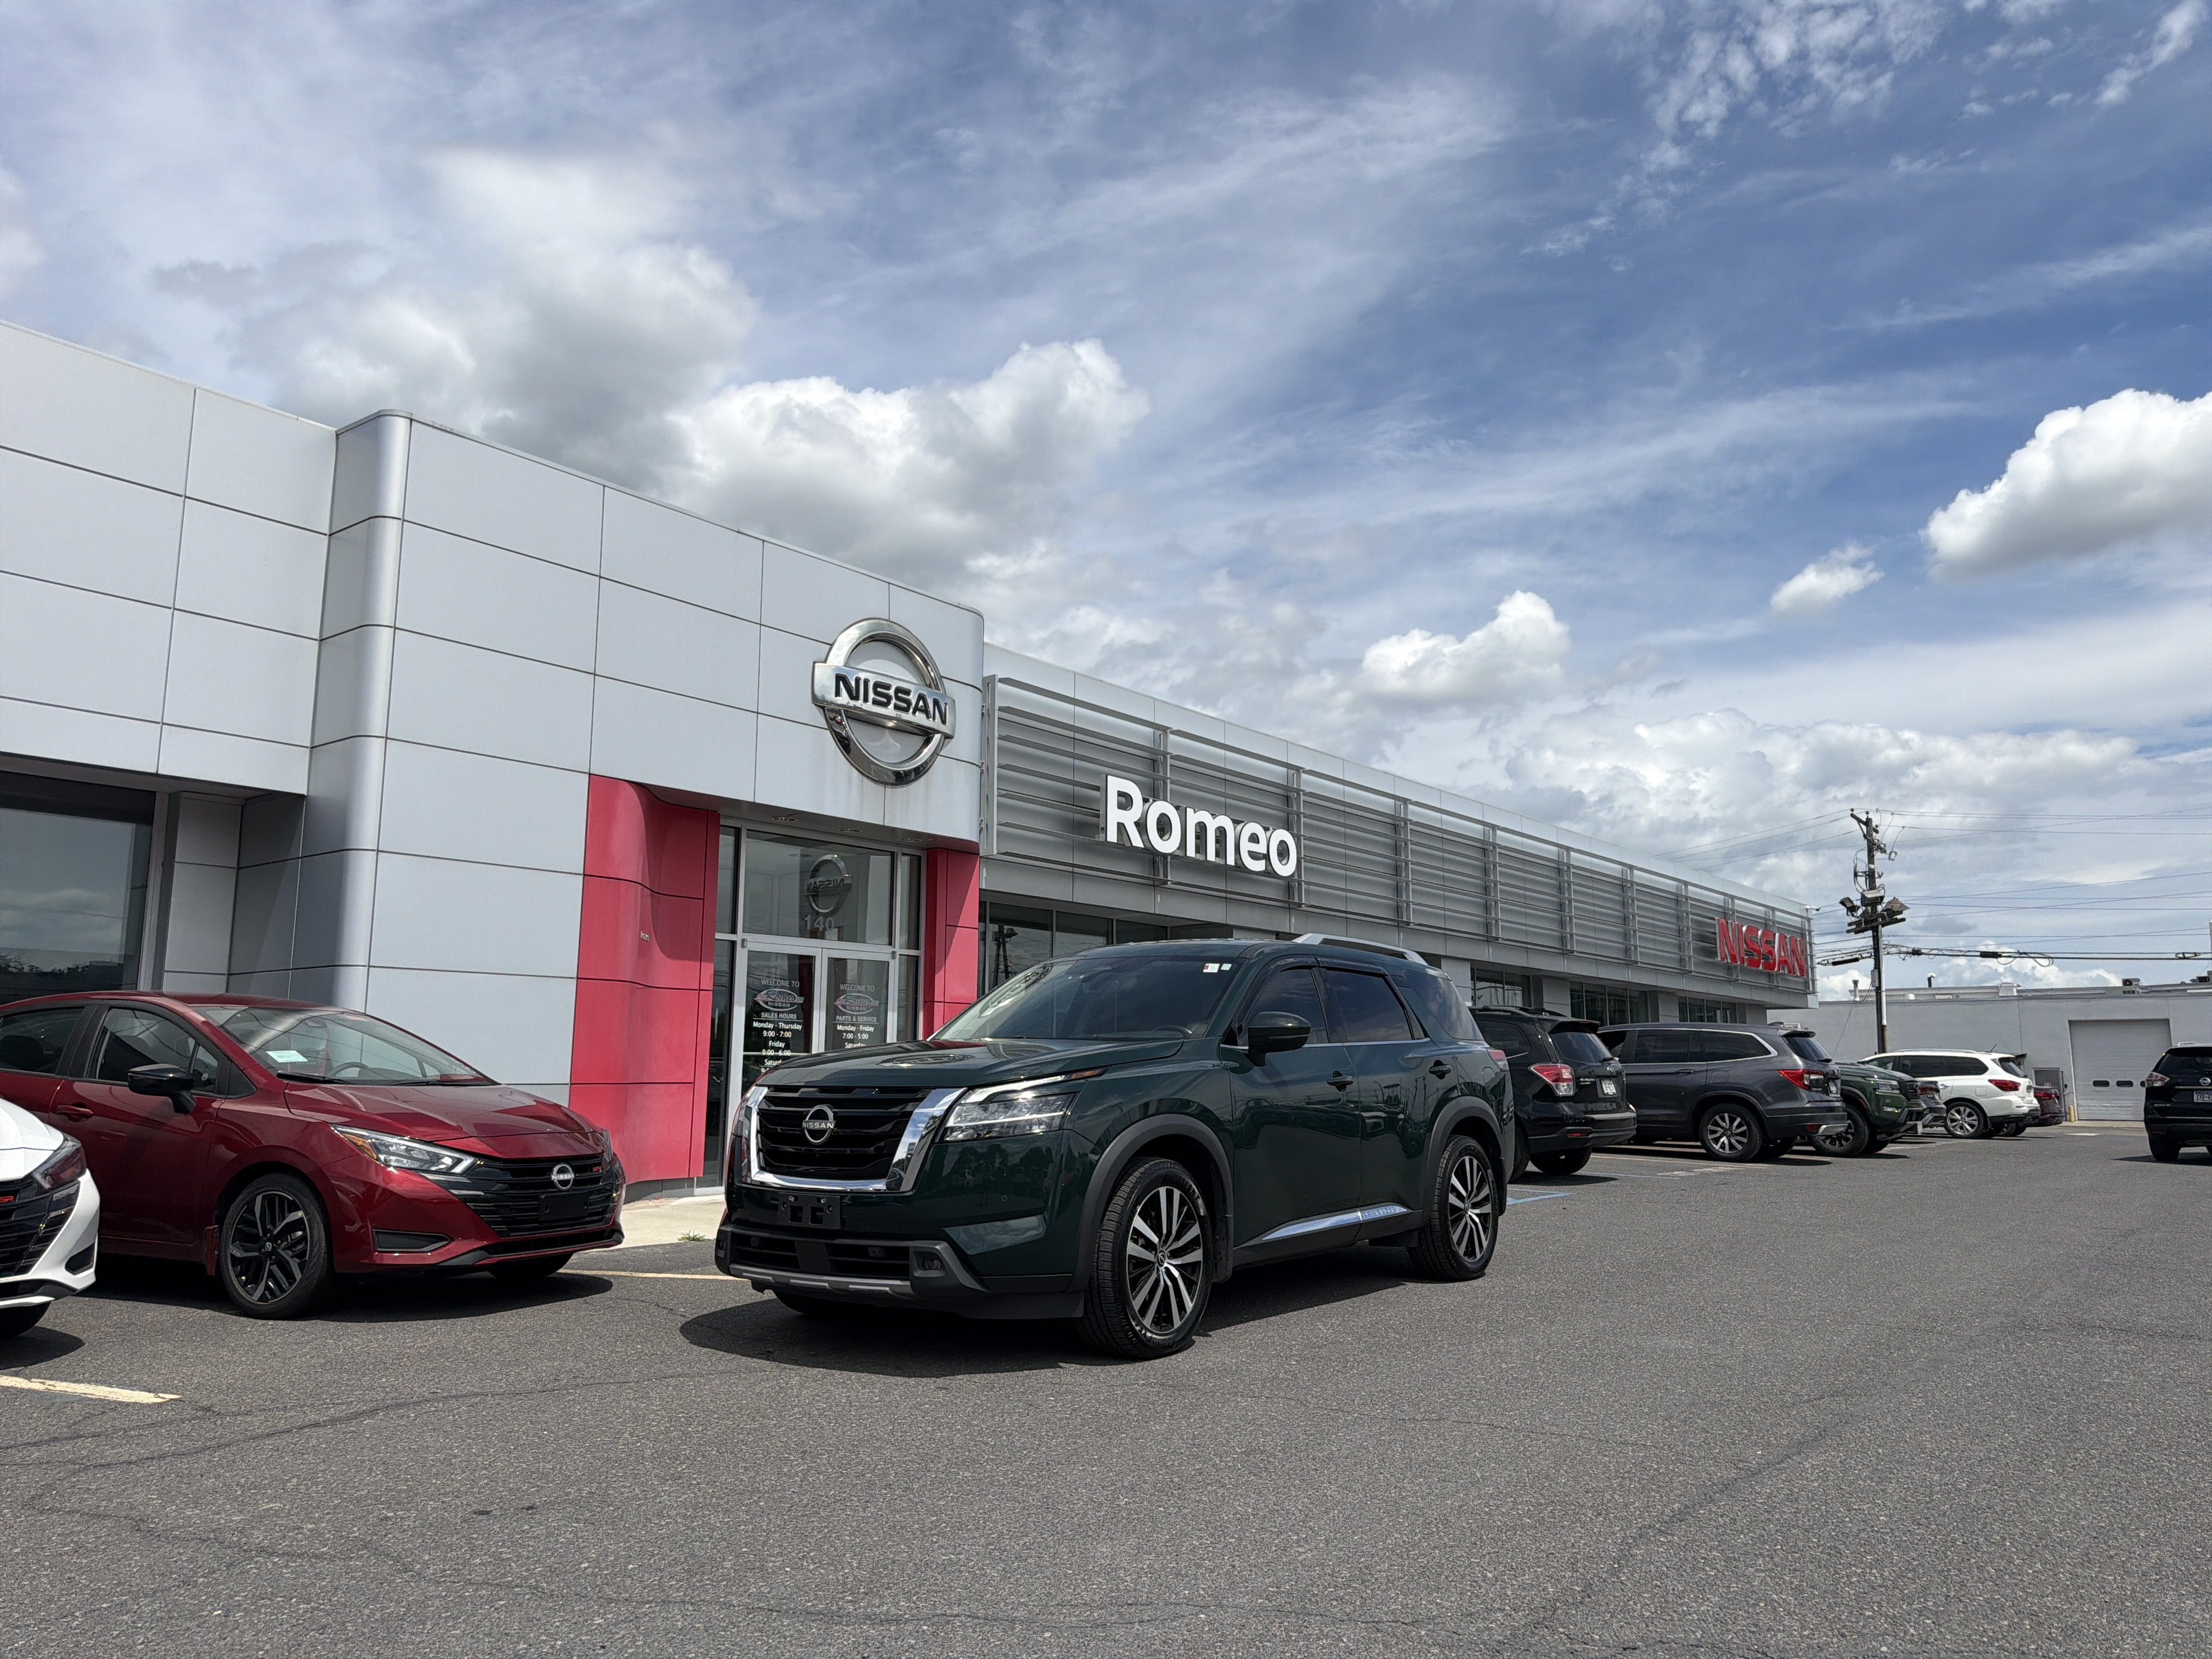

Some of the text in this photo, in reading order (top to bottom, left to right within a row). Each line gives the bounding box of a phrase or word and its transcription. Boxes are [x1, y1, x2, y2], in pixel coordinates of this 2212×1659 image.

[834, 673, 949, 726] NISSAN
[1104, 774, 1297, 877] Romeo
[804, 914, 835, 931] 140
[1717, 917, 1807, 978] NISSAN
[761, 978, 789, 987] WELCOME
[764, 990, 796, 1001] Romeo
[753, 1021, 774, 1029] Monday
[778, 1022, 803, 1030] Thursday
